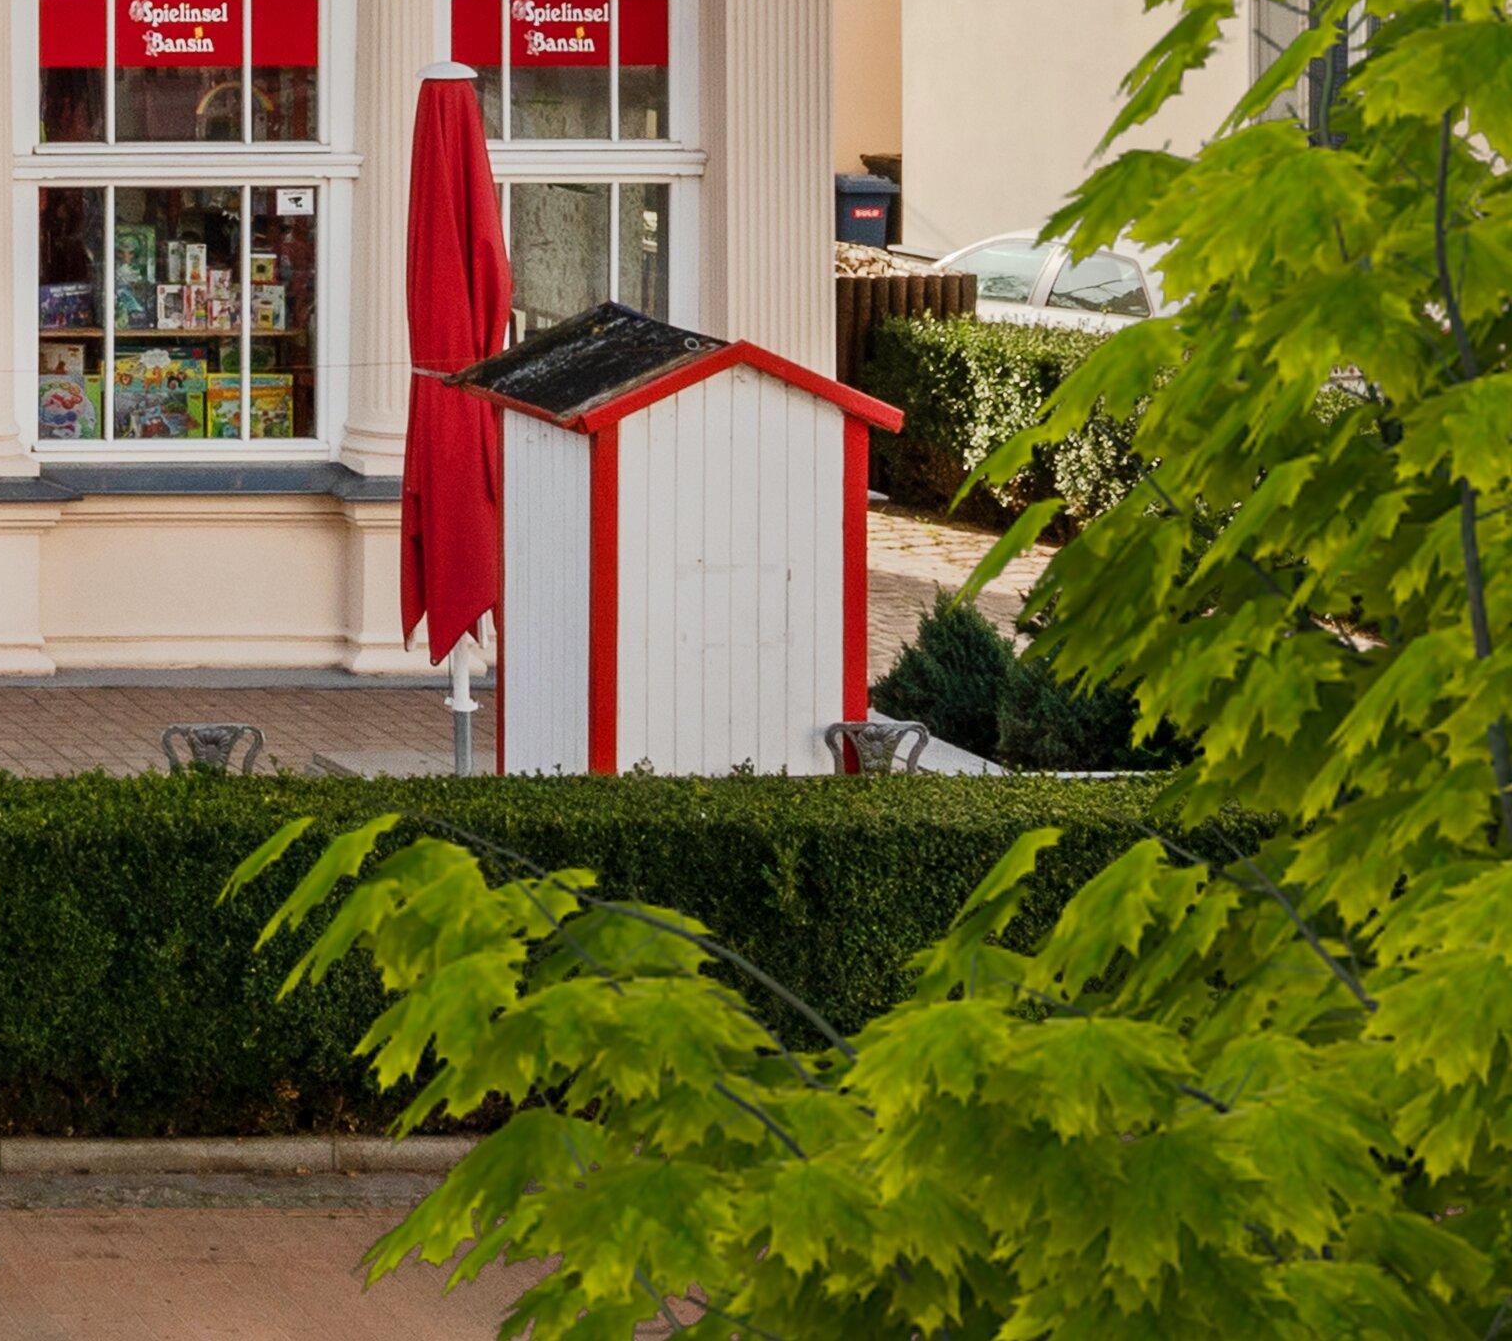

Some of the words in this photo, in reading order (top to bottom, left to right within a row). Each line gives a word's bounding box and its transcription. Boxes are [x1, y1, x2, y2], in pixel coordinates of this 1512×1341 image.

[142, 0, 229, 28] Spielinsel
[524, 0, 610, 27] Spielinsel
[151, 30, 215, 53] Bansin
[533, 30, 596, 53] Bansin
